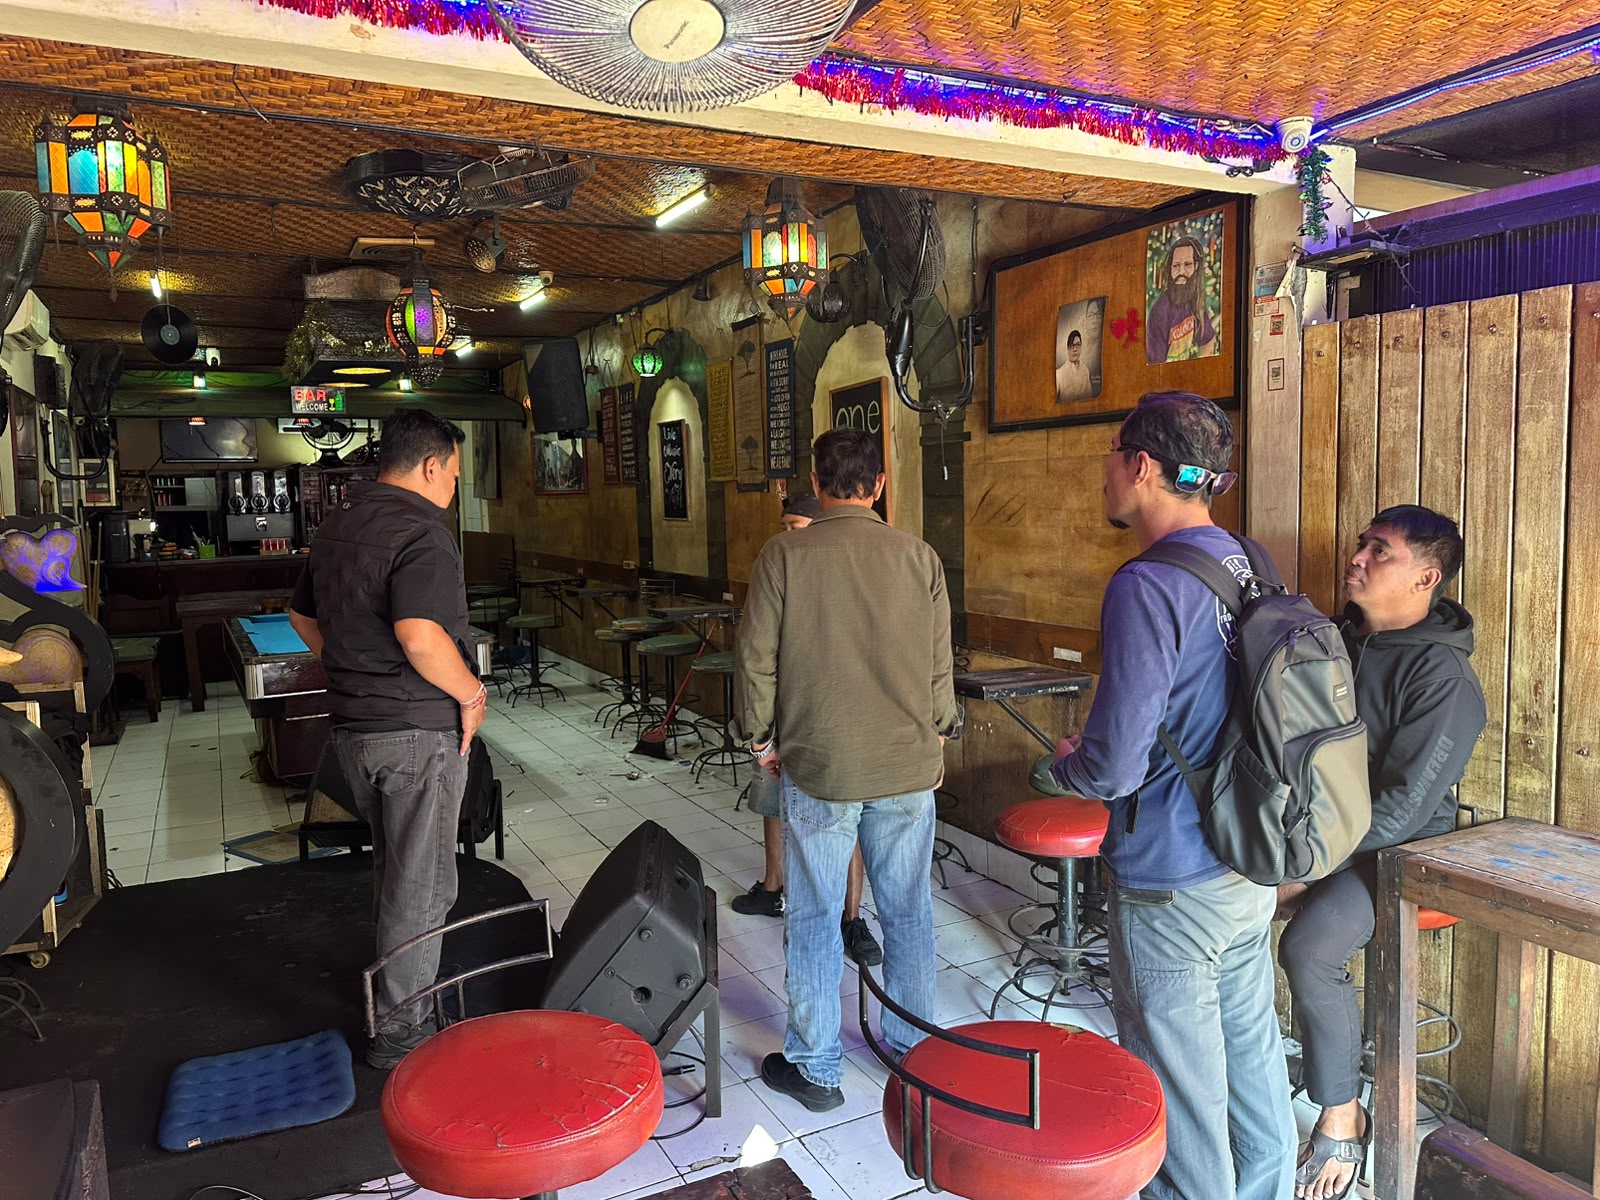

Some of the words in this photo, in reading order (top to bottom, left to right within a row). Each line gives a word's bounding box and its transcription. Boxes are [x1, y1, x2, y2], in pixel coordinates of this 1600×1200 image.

[294, 388, 327, 402] BAR
[295, 402, 329, 412] WELCOME
[835, 400, 880, 434] one
